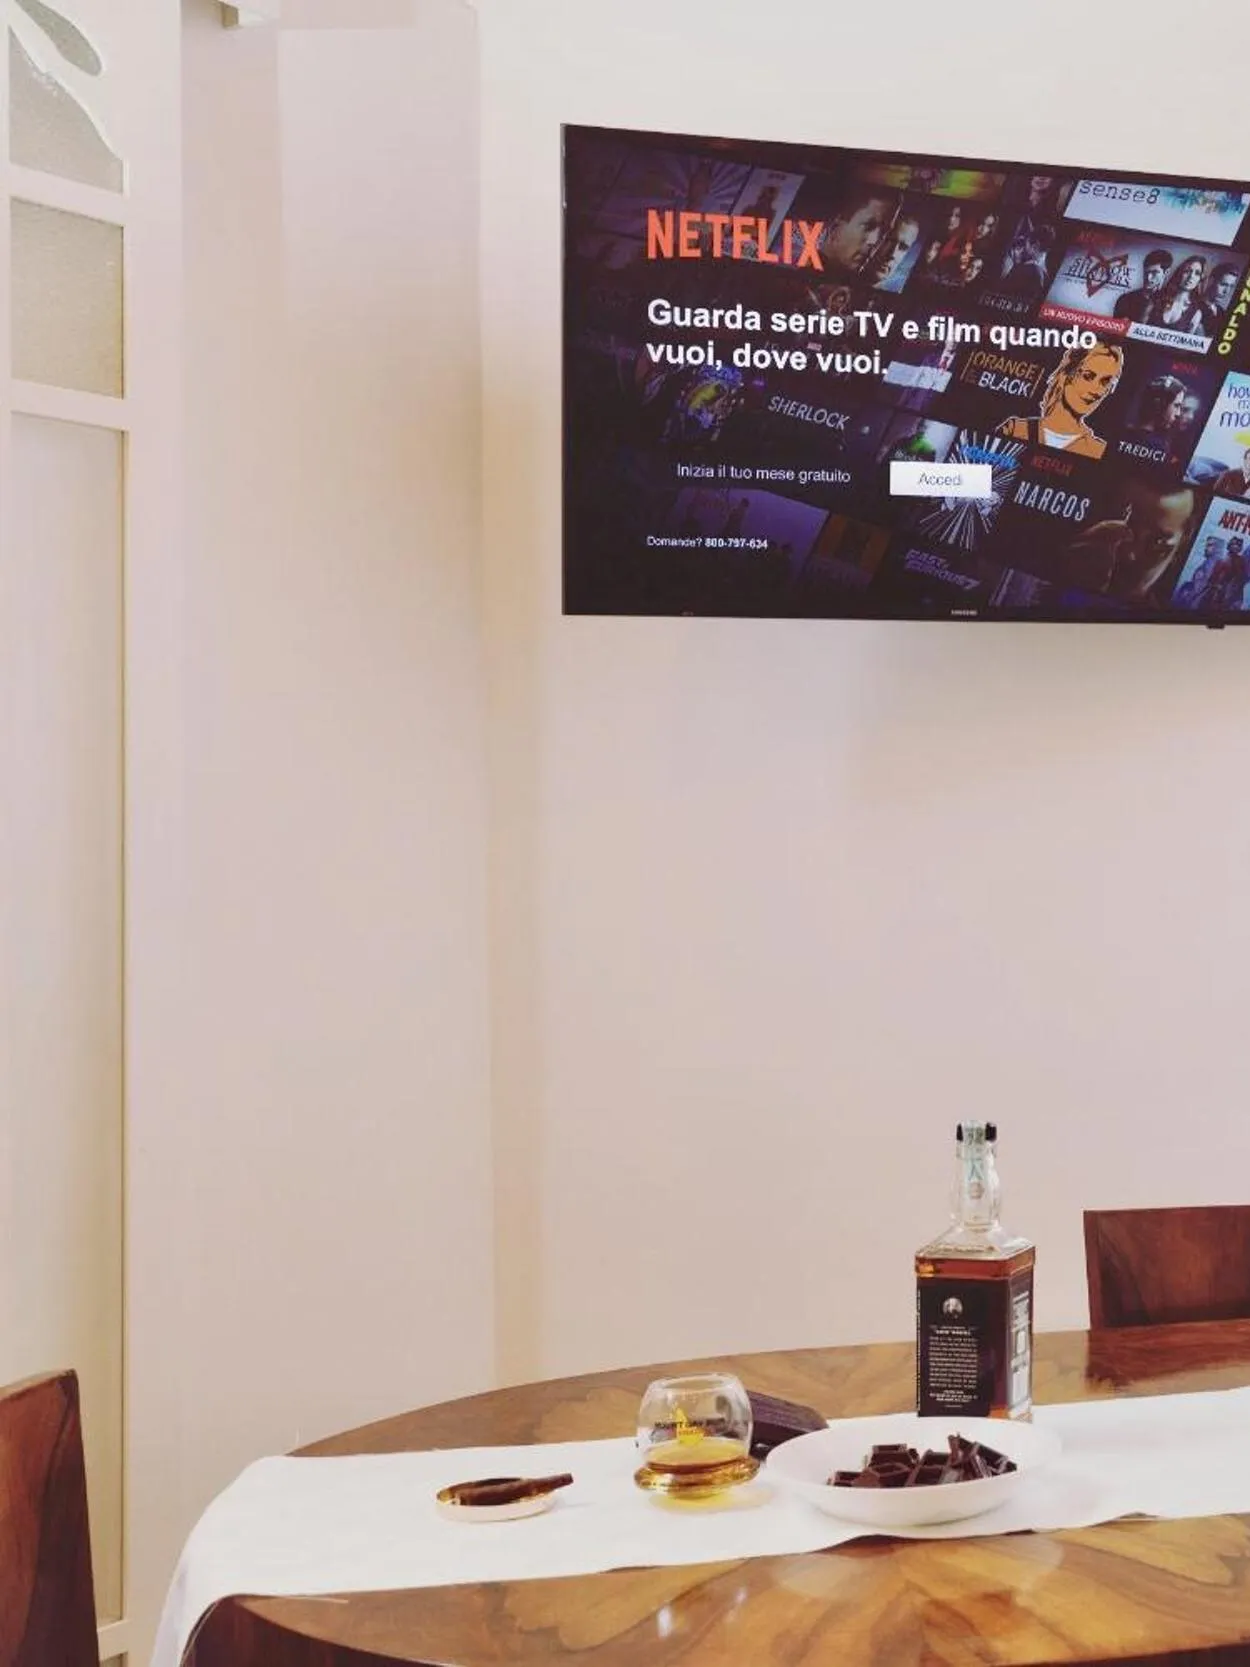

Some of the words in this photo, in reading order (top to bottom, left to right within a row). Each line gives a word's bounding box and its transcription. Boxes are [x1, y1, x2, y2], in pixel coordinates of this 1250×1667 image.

[1079, 180, 1161, 204] sense8
[646, 208, 825, 272] NETFLIX
[647, 298, 762, 332] Guarda
[770, 308, 845, 336] serie
[853, 310, 895, 338] TV
[902, 319, 920, 340] e
[927, 315, 981, 343] film
[989, 324, 1098, 351] quando
[646, 340, 724, 371] vuoi,
[732, 342, 808, 372] dove
[816, 349, 889, 375] vuoi.
[973, 351, 1039, 380] ORANGE
[978, 371, 1032, 397] BLACK
[767, 395, 850, 431] SHERLOCK
[1118, 441, 1167, 462] TREDICI
[677, 462, 715, 478] Inizia
[717, 464, 727, 478] il
[730, 466, 752, 480] tuo
[755, 469, 796, 482] mese
[799, 468, 852, 485] gratuito
[919, 472, 964, 487] Acced
[1013, 481, 1091, 522] NARCOS
